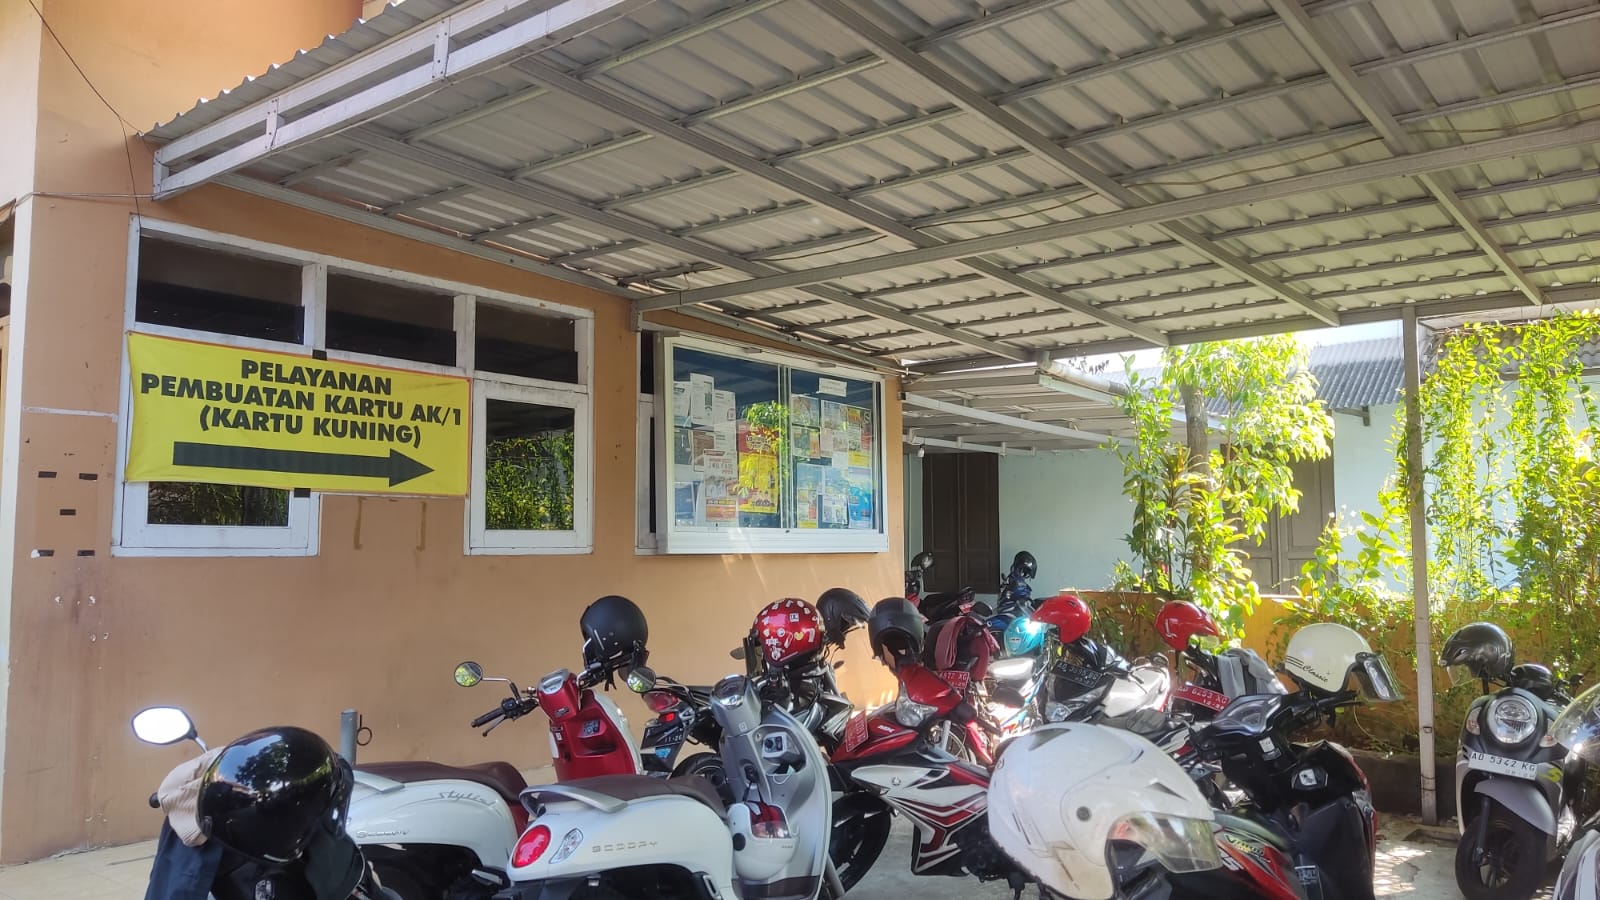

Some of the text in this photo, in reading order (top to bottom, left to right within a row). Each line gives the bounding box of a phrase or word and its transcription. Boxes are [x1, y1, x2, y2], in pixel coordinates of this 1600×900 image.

[241, 359, 392, 395] PELAYANAN
[141, 373, 461, 426] PEMBUATAN KARTU AK/1
[200, 404, 421, 449] (KARTU KUNING)
[1302, 665, 1329, 683] Classic
[1471, 752, 1536, 772] AD 5342 KG
